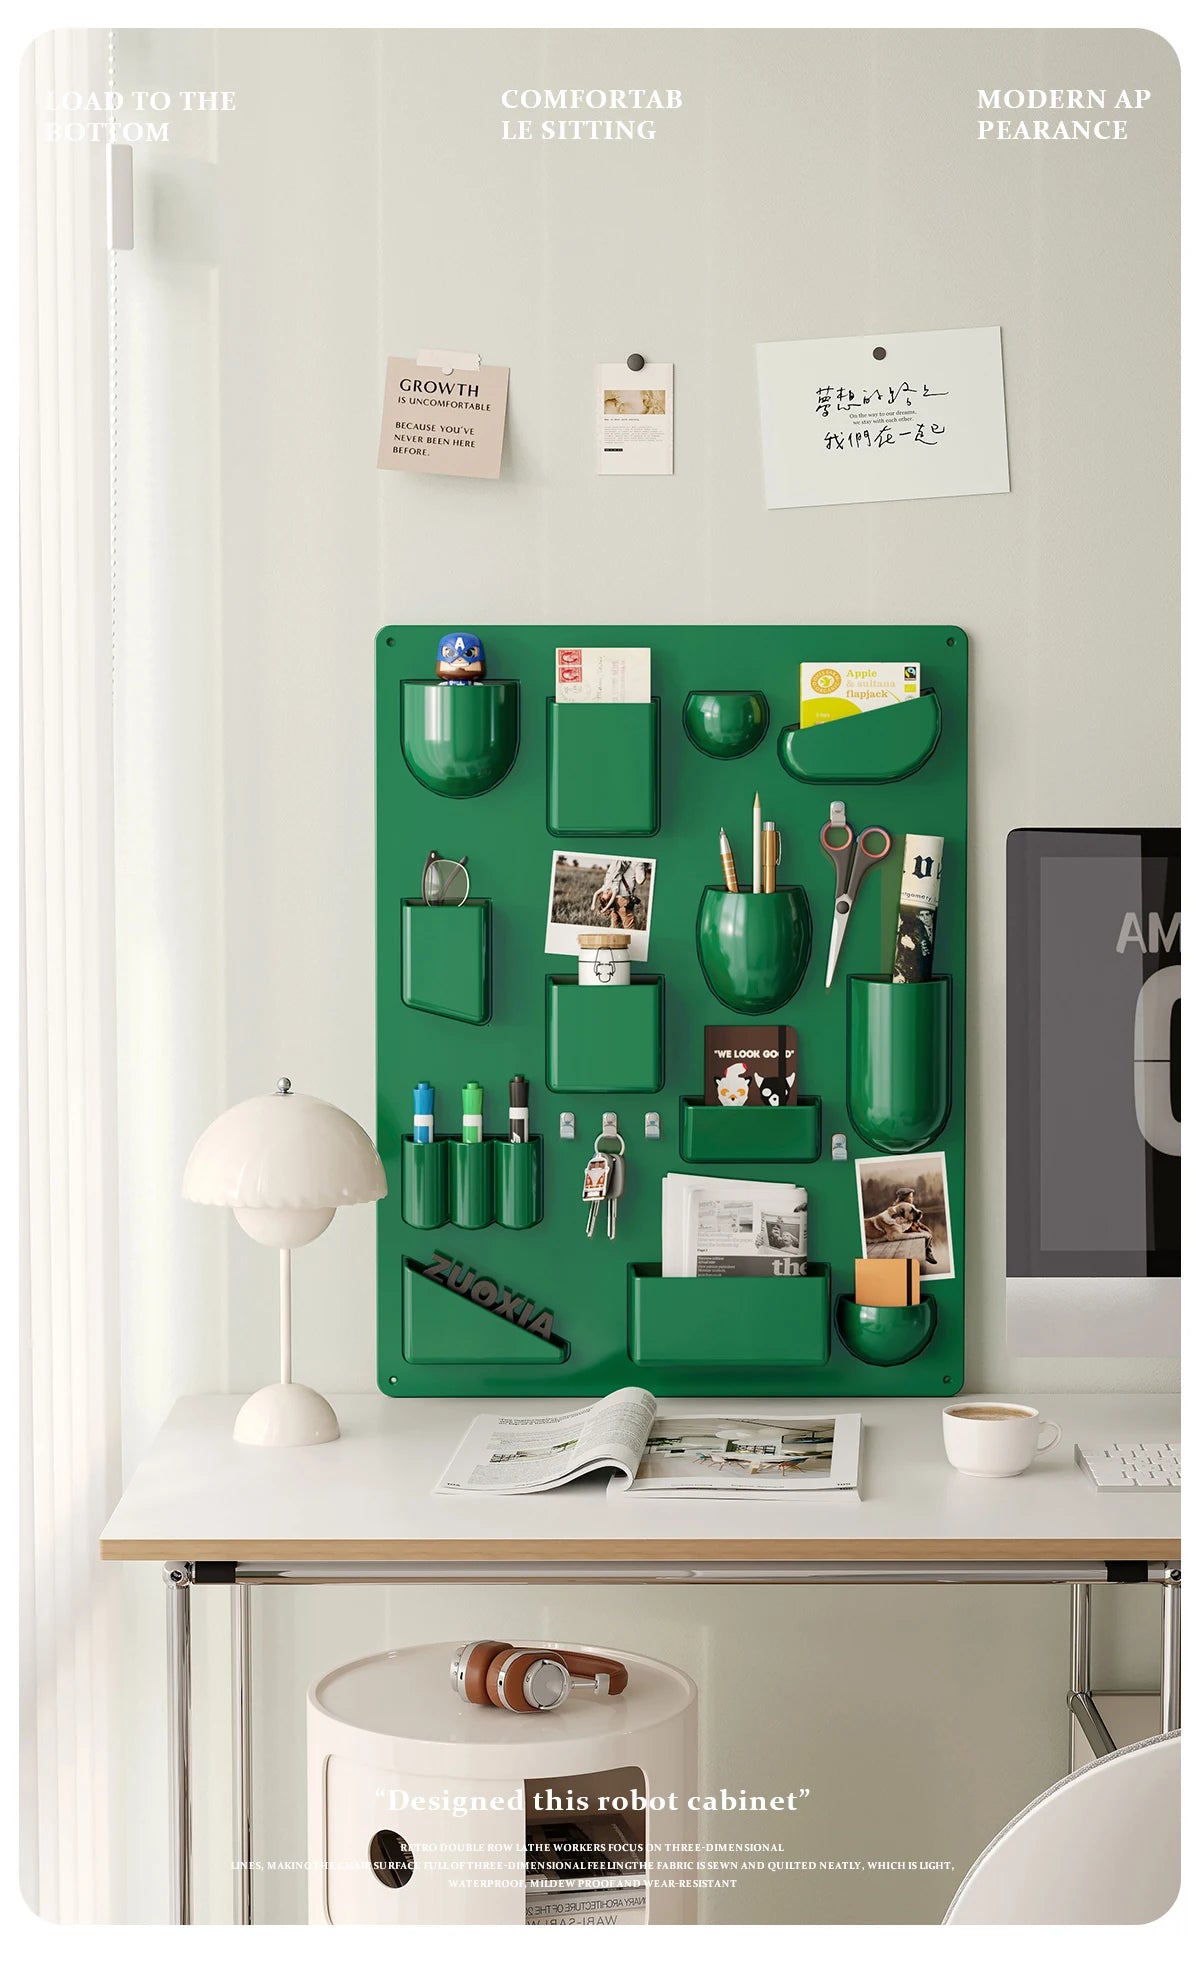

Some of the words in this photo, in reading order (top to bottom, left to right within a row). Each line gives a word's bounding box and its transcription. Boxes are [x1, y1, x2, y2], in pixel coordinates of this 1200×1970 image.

[399, 378, 479, 398] GROWTH
[397, 396, 407, 404] IS
[409, 397, 492, 412] UNCOMFORTABLE
[395, 421, 437, 433] BECAUSE
[393, 434, 424, 444] NEVER
[426, 436, 450, 446] BEEN
[452, 439, 476, 448] HERE
[392, 446, 430, 457] BEFORE.
[846, 669, 878, 679] Apple
[846, 680, 854, 688] &
[856, 679, 896, 688] sultana
[846, 689, 888, 700] flapjack
[733, 1049, 761, 1059] LOOK
[762, 1049, 795, 1059] GOD"
[423, 1253, 555, 1341] ZUOXIA
